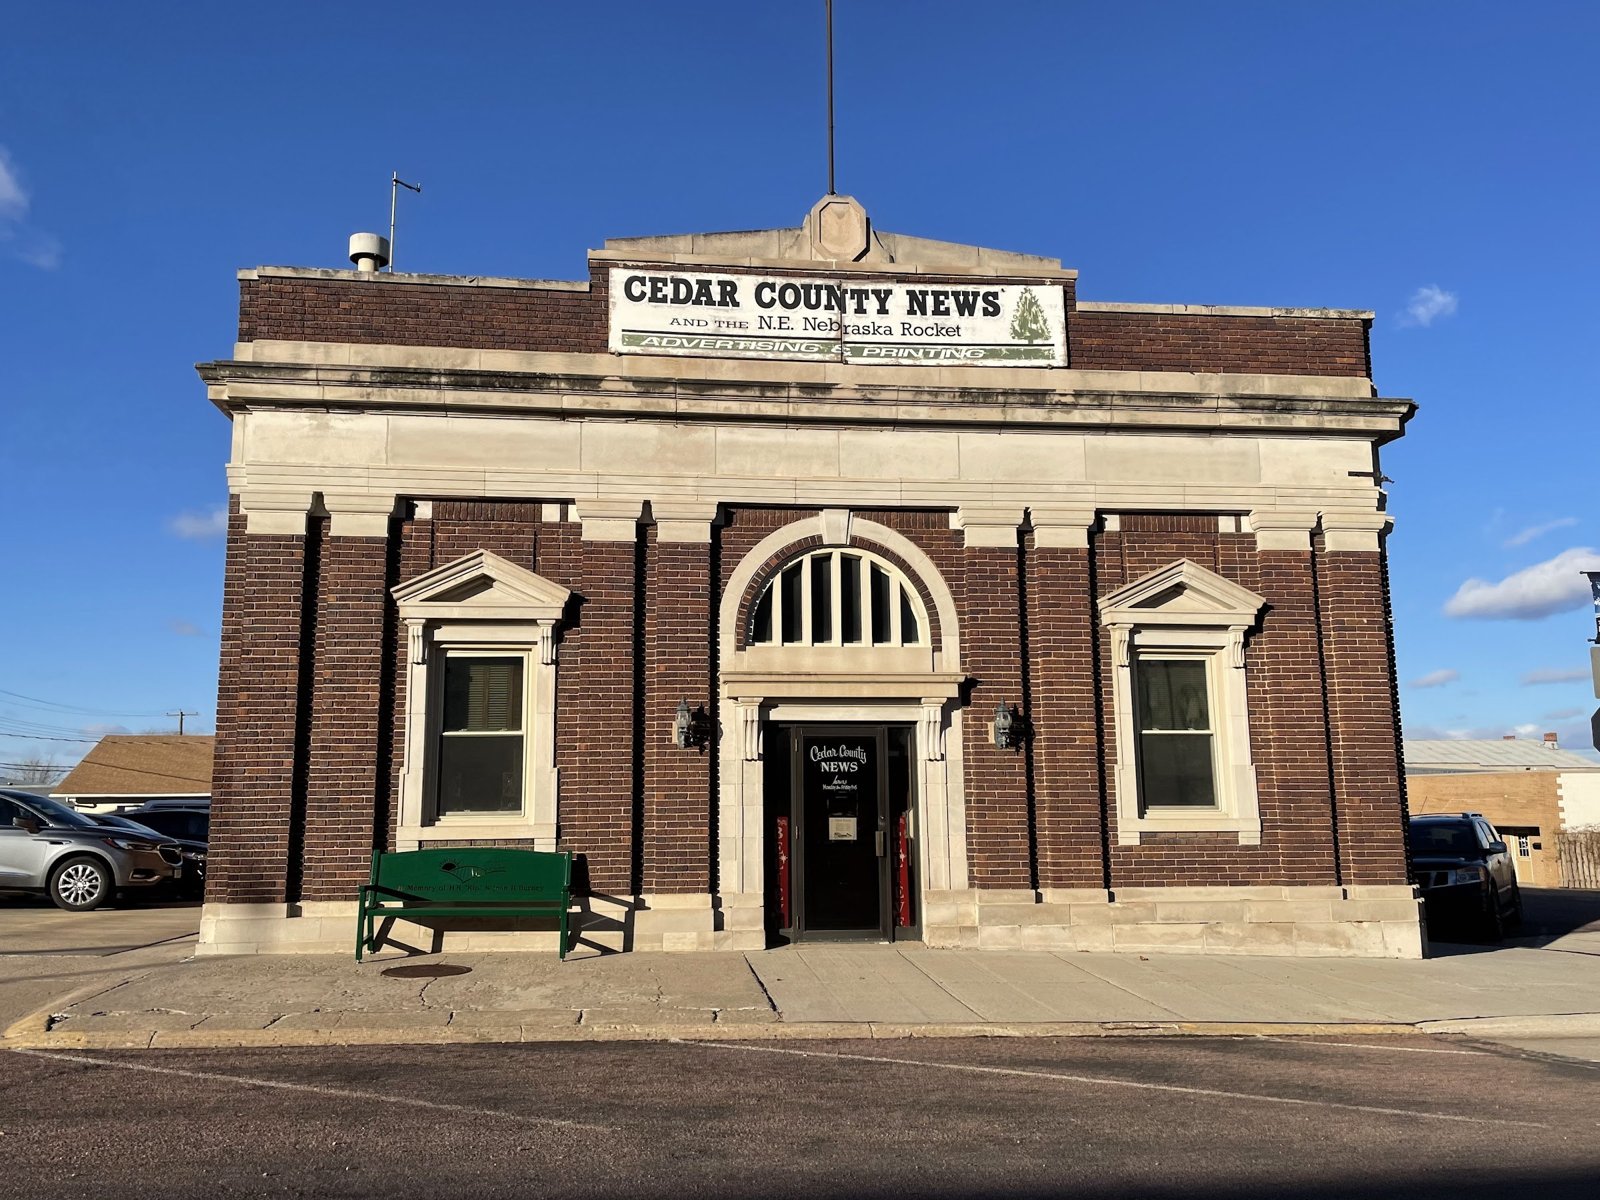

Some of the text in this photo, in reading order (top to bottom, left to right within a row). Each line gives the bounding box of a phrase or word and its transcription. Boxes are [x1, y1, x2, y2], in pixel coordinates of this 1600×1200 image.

[624, 275, 740, 307] CEDAR
[754, 281, 893, 314] COUNTY
[670, 315, 962, 337] AND THE N.E. Nebraska Rocket
[640, 336, 820, 353] ADVERTISING
[862, 347, 985, 359] PRINTING
[810, 744, 867, 764] Cedar County
[820, 761, 858, 773] NEWS
